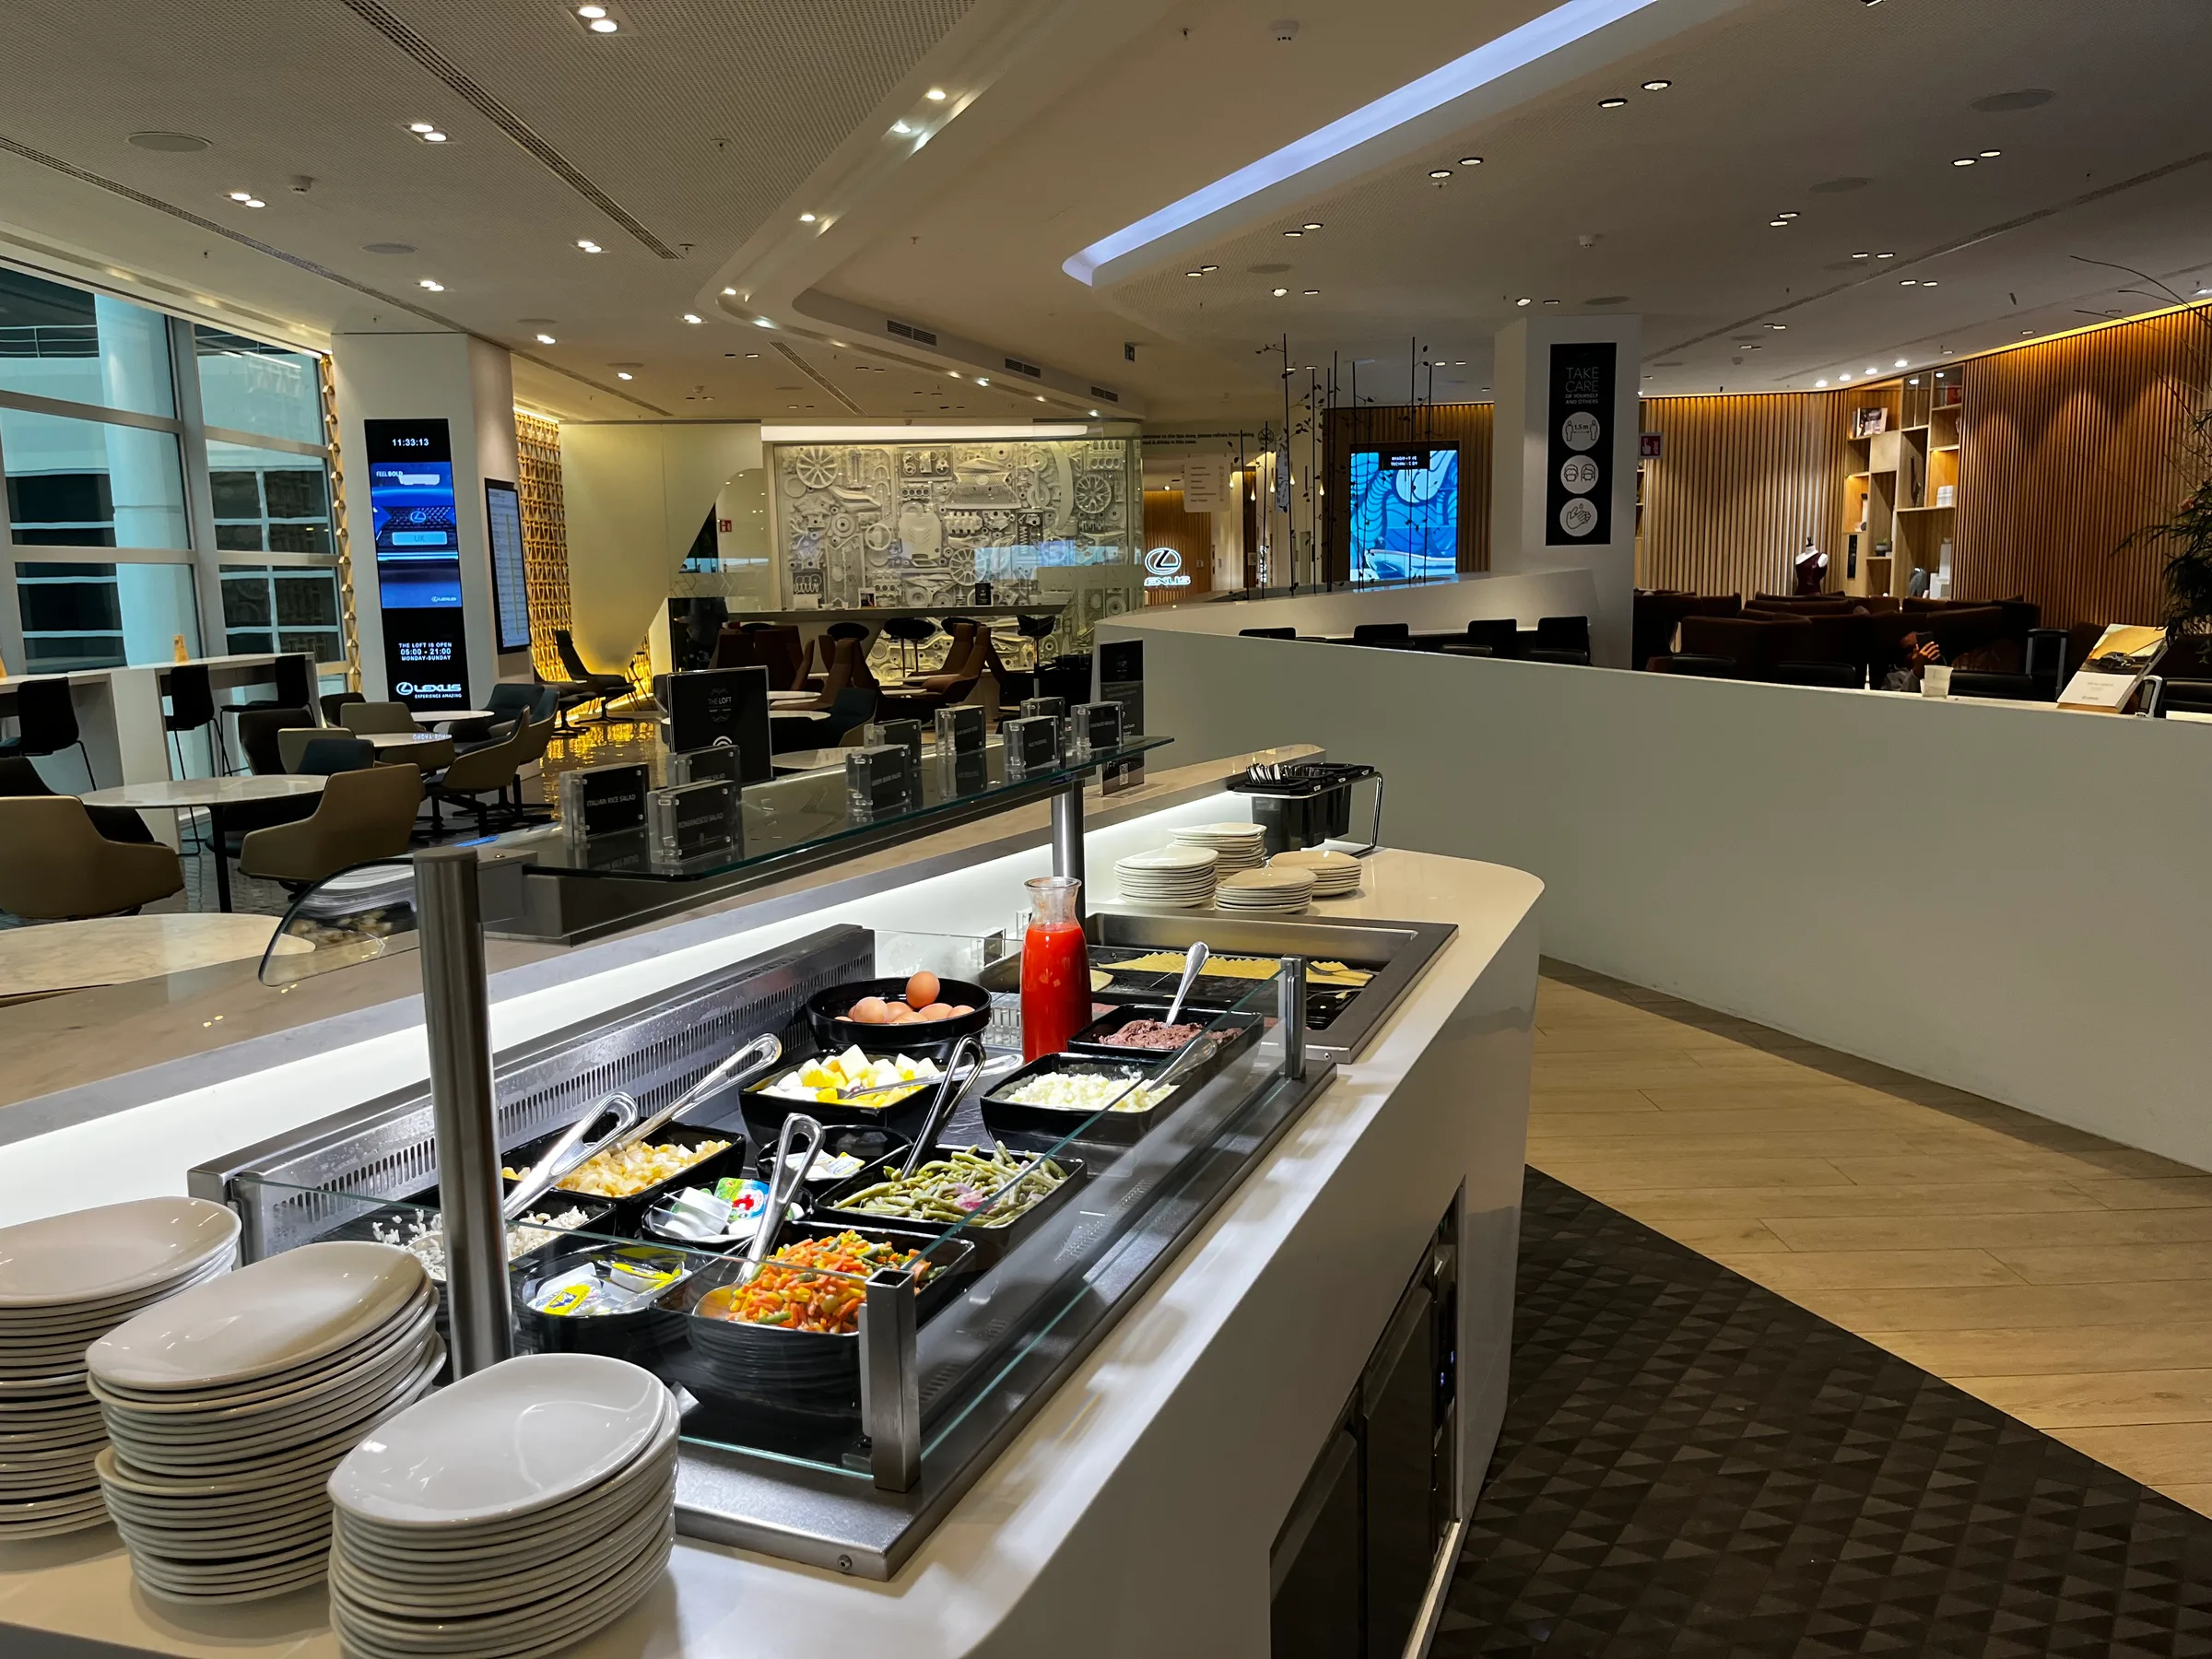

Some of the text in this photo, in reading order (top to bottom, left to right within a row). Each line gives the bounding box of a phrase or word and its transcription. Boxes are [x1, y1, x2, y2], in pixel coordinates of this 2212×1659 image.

[1566, 367, 1599, 379] TAKE
[1565, 380, 1599, 393] CARE
[392, 438, 429, 446] 11:33:13
[1144, 575, 1191, 586] EXUS
[414, 684, 462, 693] LEXUS
[718, 696, 732, 704] LOFT
[586, 794, 636, 807] ITALIAN RICE SALAD
[677, 812, 724, 829] ROMANESCO SALAD
